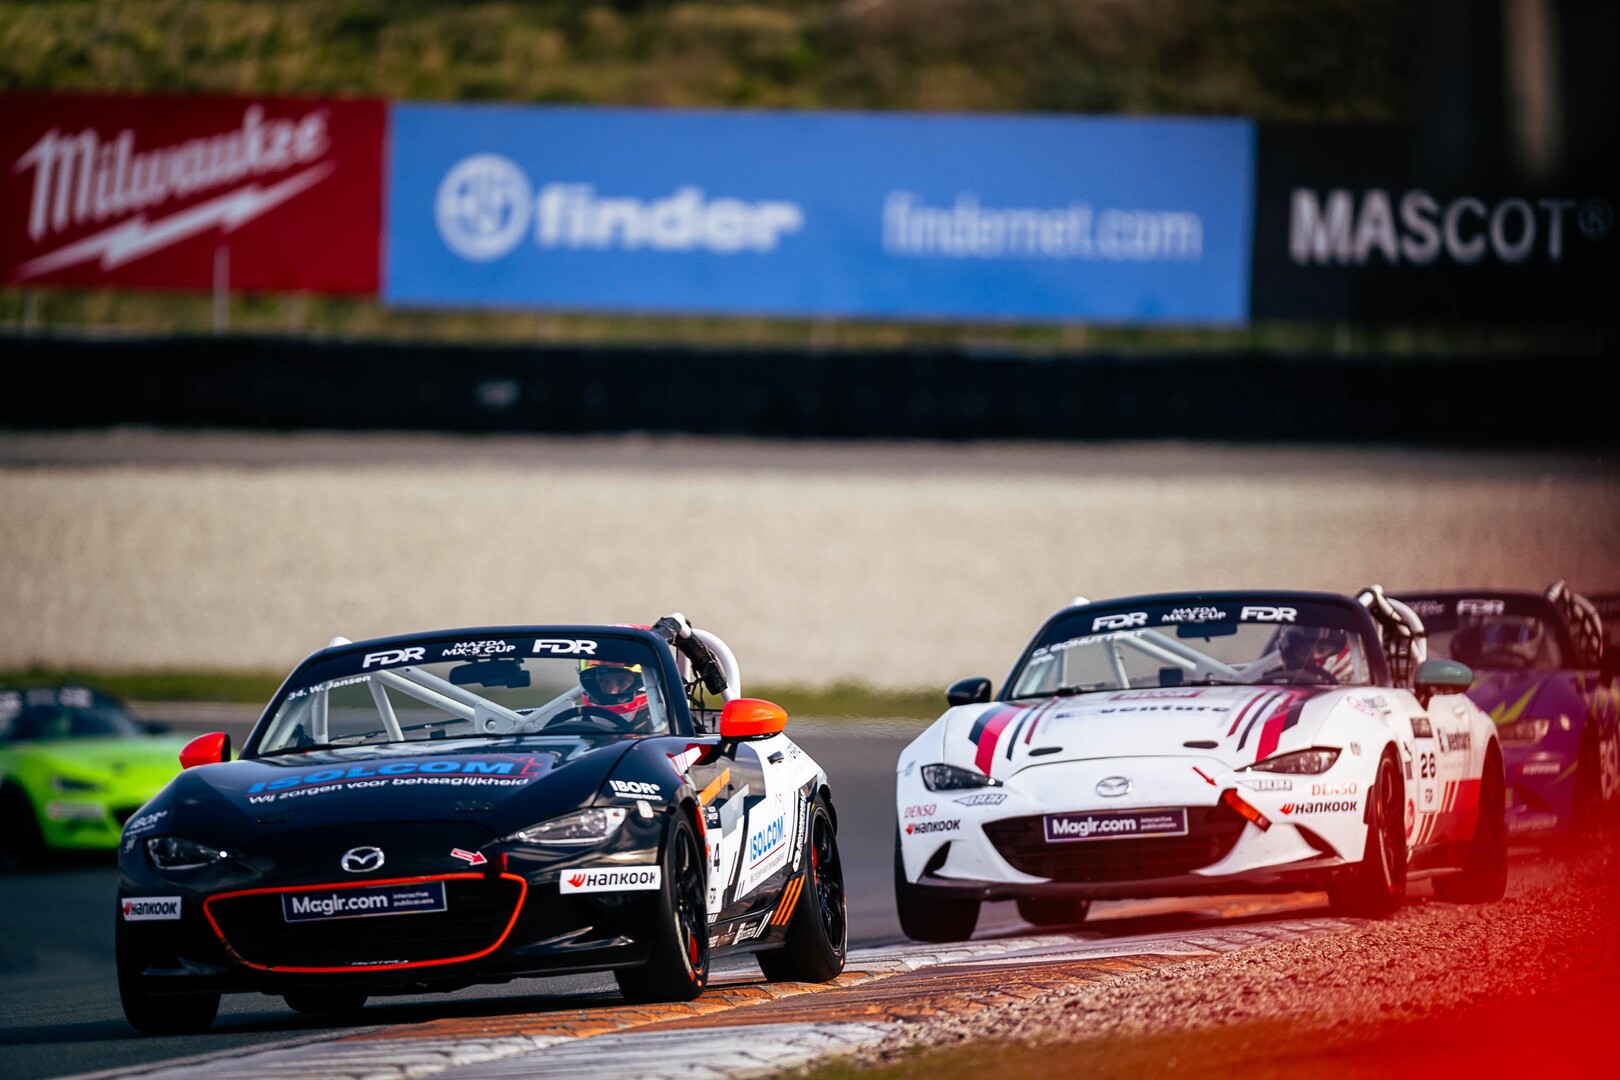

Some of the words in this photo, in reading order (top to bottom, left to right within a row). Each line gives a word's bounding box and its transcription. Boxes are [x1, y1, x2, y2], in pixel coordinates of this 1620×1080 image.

[12, 104, 331, 243] Milwaukee
[537, 183, 803, 253] finder
[882, 191, 1202, 260] findernet.com
[1092, 611, 1148, 631] FDR
[1172, 606, 1217, 615] MAZDA
[1240, 606, 1298, 622] FDR
[441, 646, 482, 656] MX-5
[484, 644, 516, 653] CUP
[454, 640, 506, 649] MAZDA
[532, 638, 598, 655] FDR
[362, 646, 426, 669] FDR
[326, 674, 371, 690] Jansen
[1420, 752, 1436, 778] 26
[248, 760, 515, 793] ISOLCOM
[249, 794, 276, 804] Wij
[279, 783, 342, 799] zorgen
[347, 778, 389, 789] voor
[392, 776, 529, 787] behaaglijkheid
[904, 804, 937, 818] DENSO
[750, 815, 783, 862] ISOLCOM
